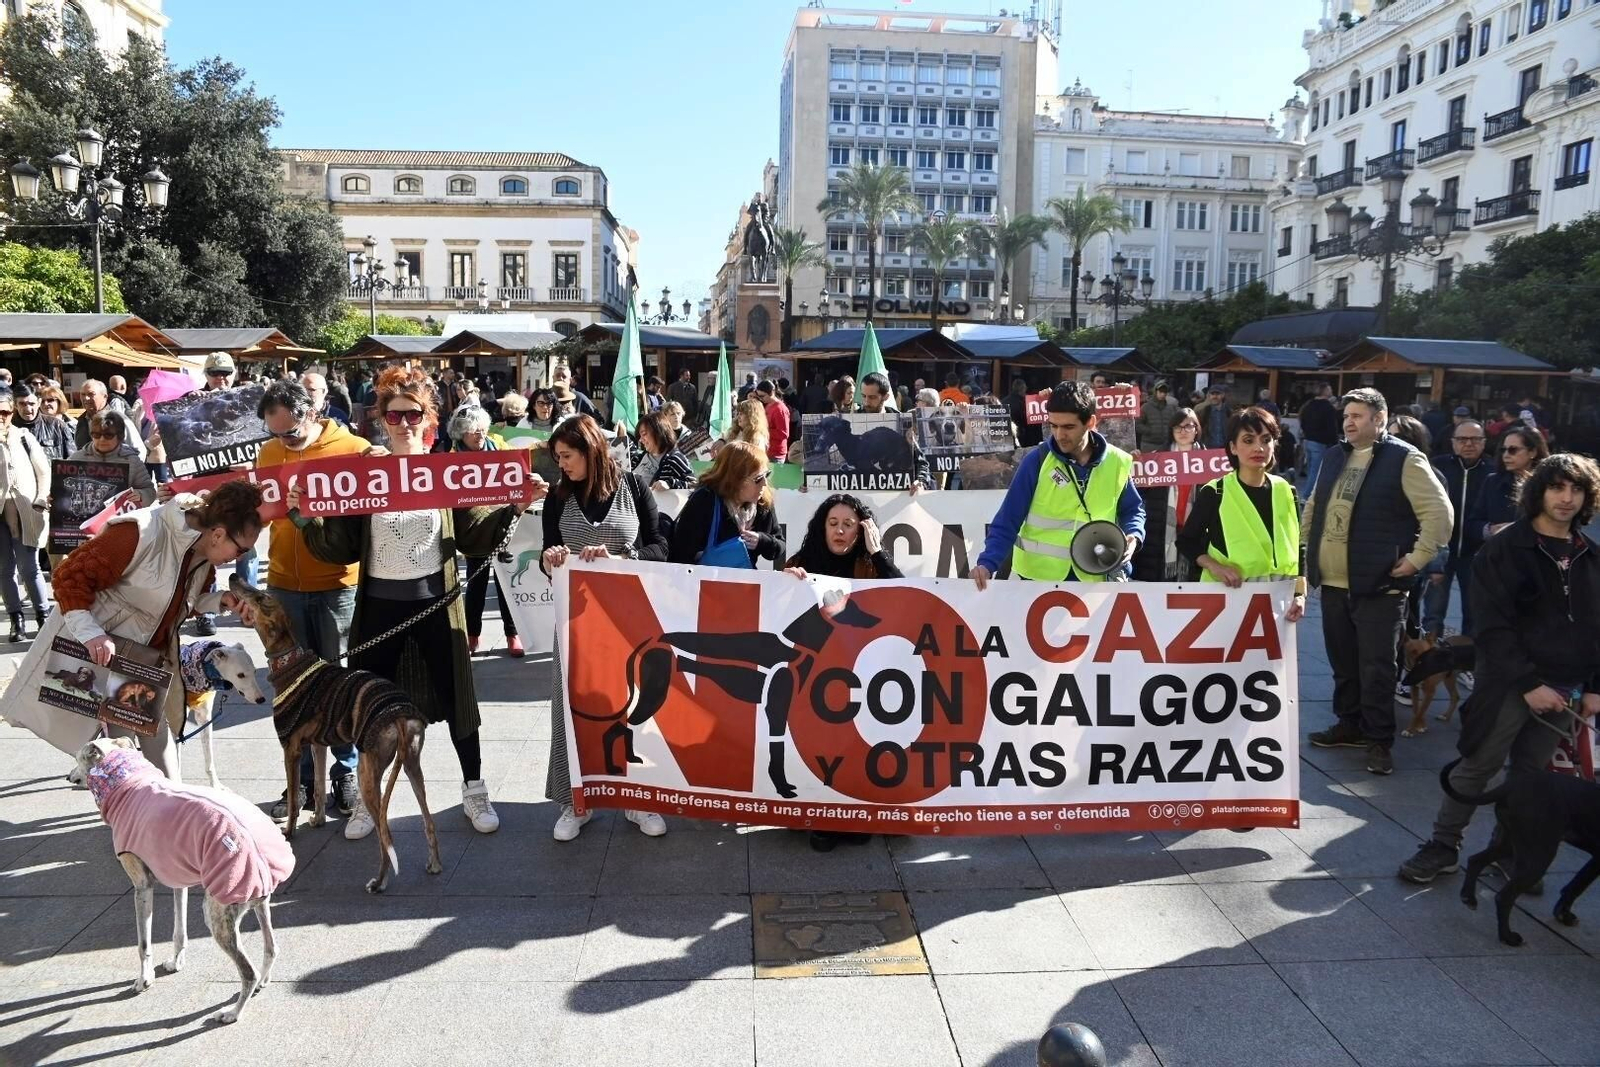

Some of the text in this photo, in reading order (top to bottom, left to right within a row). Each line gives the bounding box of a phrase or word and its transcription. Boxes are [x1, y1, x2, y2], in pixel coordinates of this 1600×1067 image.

[56, 463, 124, 477] NO CAZA
[197, 453, 216, 472] NO
[218, 450, 229, 467] A
[228, 446, 246, 464] LA
[936, 456, 953, 471] NO
[1164, 458, 1178, 475] a
[1182, 452, 1205, 474] la
[1209, 456, 1234, 473] ca
[306, 470, 357, 499] no
[367, 468, 389, 495] a
[398, 458, 433, 493] la
[442, 461, 524, 491] caza
[831, 472, 912, 490] NO A LA CAZA
[1147, 475, 1177, 485] perros
[308, 496, 388, 513] con perros
[913, 590, 1283, 664] A LA CAZA
[569, 569, 987, 804] NO
[810, 667, 1282, 727] CON GALGOS
[815, 737, 1285, 788] Y OTRAS RAZAS
[583, 785, 1130, 823] anto más indefensa está una criatura, más derecho tiene a ser defendida
[1211, 805, 1288, 815] plataformanac.org
